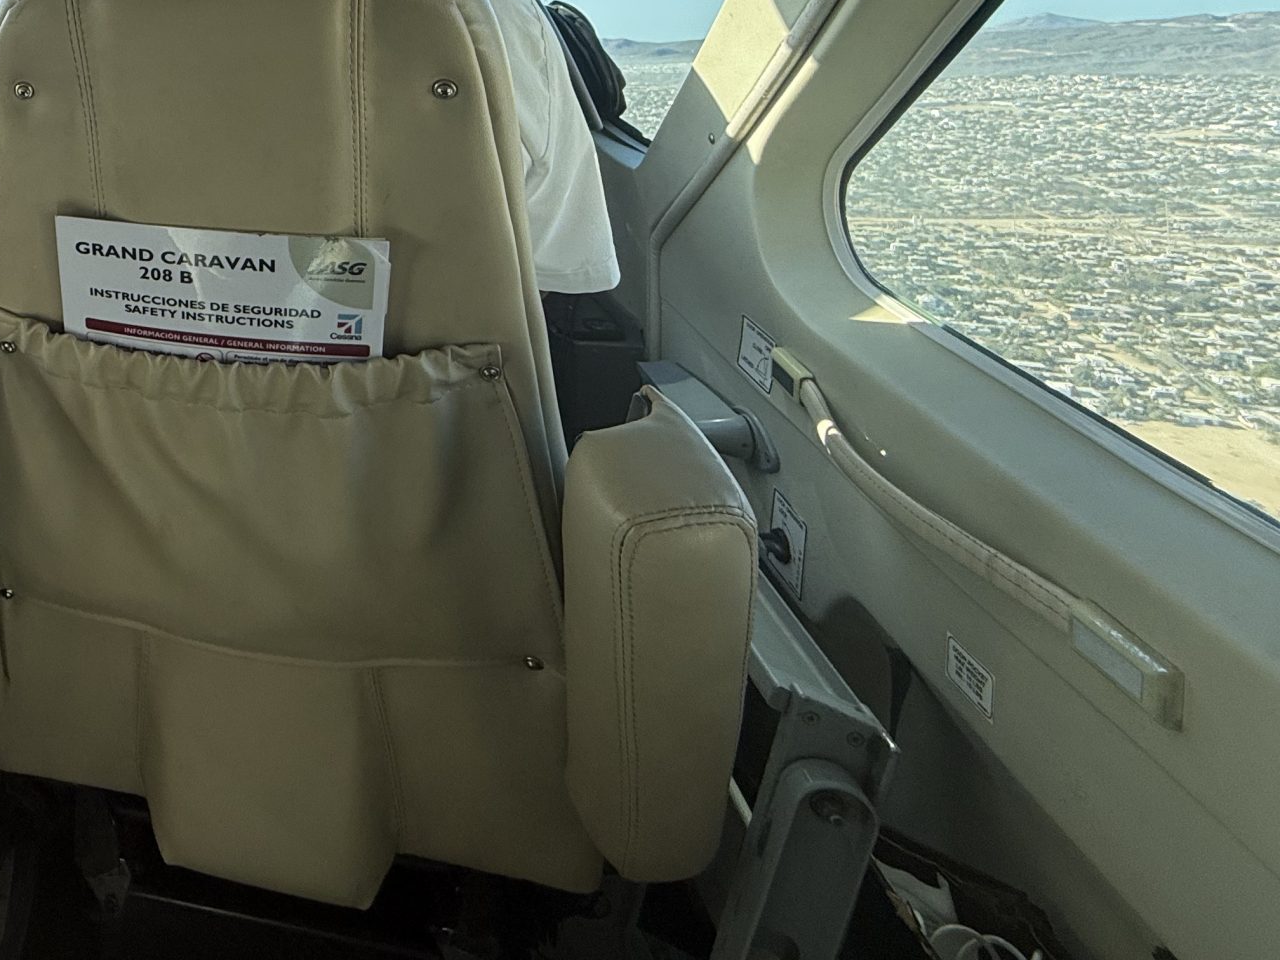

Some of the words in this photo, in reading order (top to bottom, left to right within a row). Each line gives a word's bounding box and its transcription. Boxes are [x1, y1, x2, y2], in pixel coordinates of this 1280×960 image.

[74, 241, 154, 262] GRAND
[160, 251, 276, 273] CARAVAN
[138, 265, 173, 283] 208
[180, 271, 194, 285] B
[89, 287, 206, 310] INSTRUCCIONES
[209, 301, 230, 313] DE
[233, 303, 322, 320] SEGURIDAD
[124, 303, 176, 319] SAFETY
[181, 310, 295, 330] INSTRUCTIONS
[182, 333, 219, 345] GENERAL
[227, 339, 264, 350] GENERAL
[266, 343, 326, 354] INFORMATION
